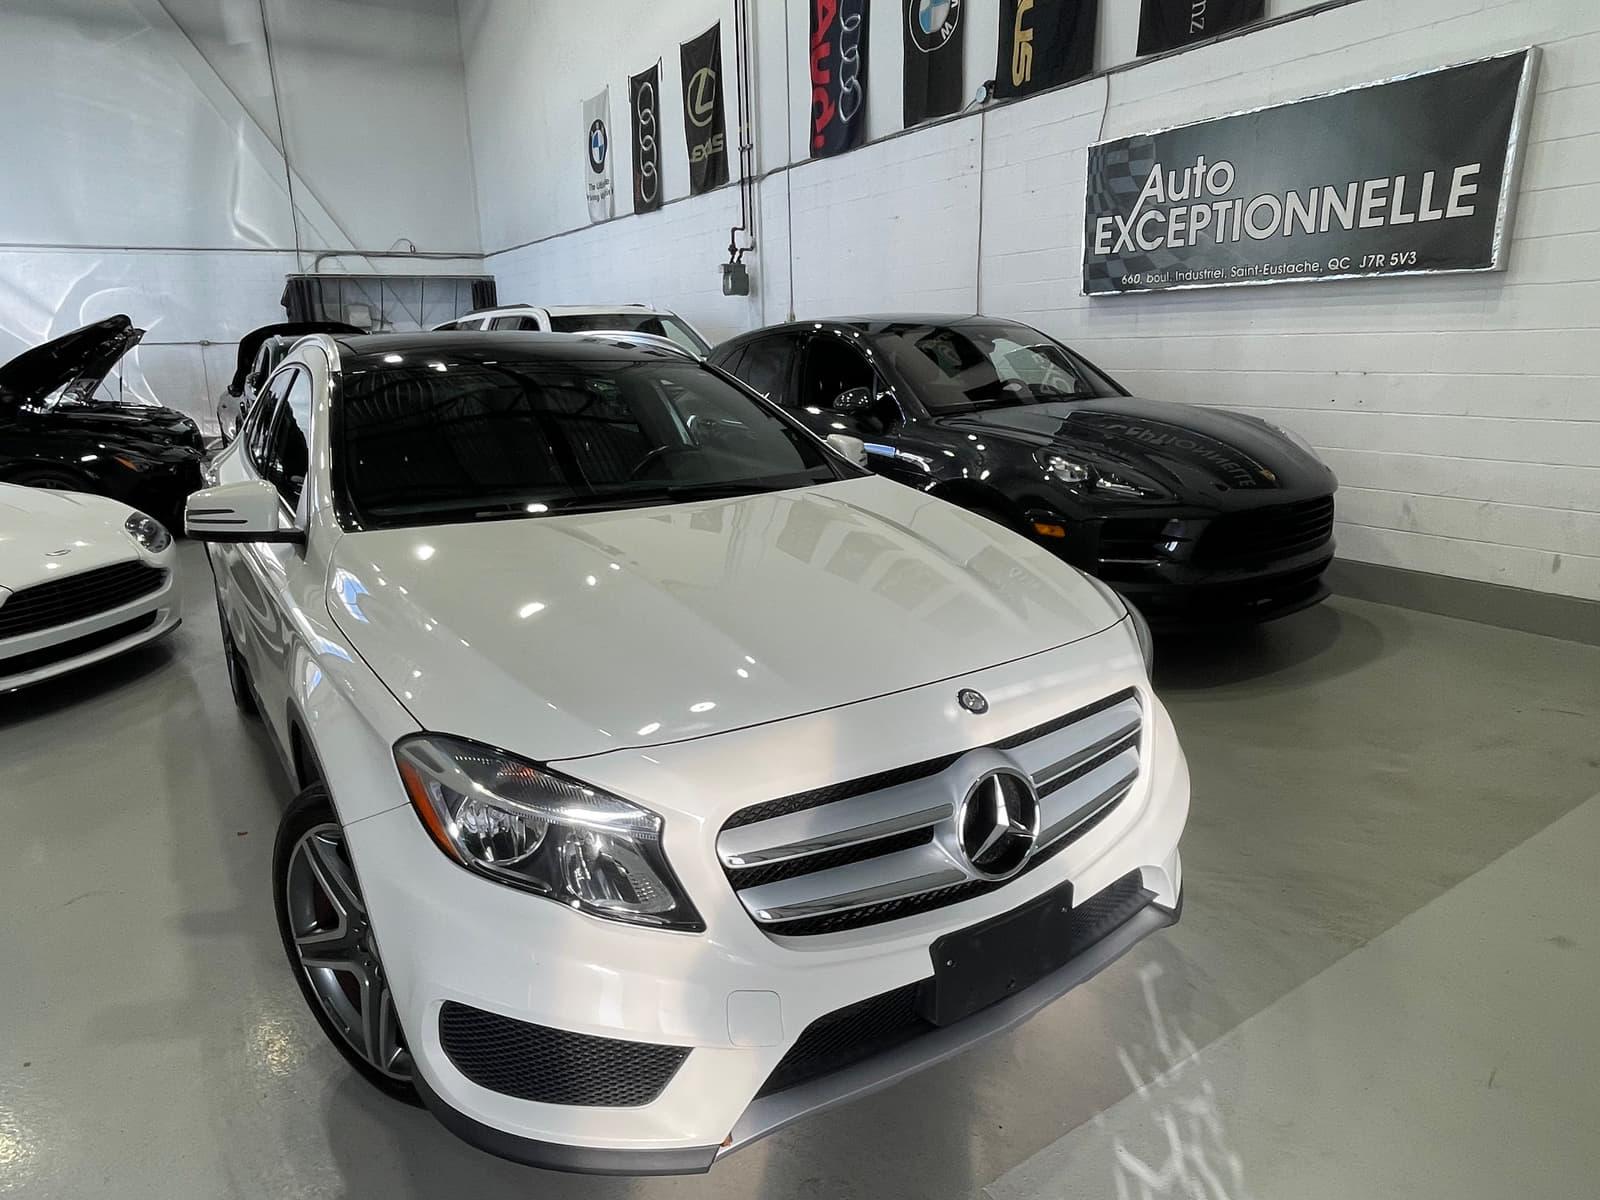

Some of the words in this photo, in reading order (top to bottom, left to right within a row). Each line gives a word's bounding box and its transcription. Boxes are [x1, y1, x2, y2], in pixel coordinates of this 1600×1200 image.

[1012, 0, 1034, 87] US
[1094, 162, 1482, 256] EXCEPTIONNELLE
[1137, 155, 1236, 204] Auto
[1146, 271, 1173, 284] boul.
[1175, 267, 1227, 282] Industriel,
[1230, 260, 1324, 278] Saint-Eustache,
[1328, 257, 1351, 271] QC
[1359, 254, 1385, 269] J7R
[1389, 251, 1417, 266] 5V3
